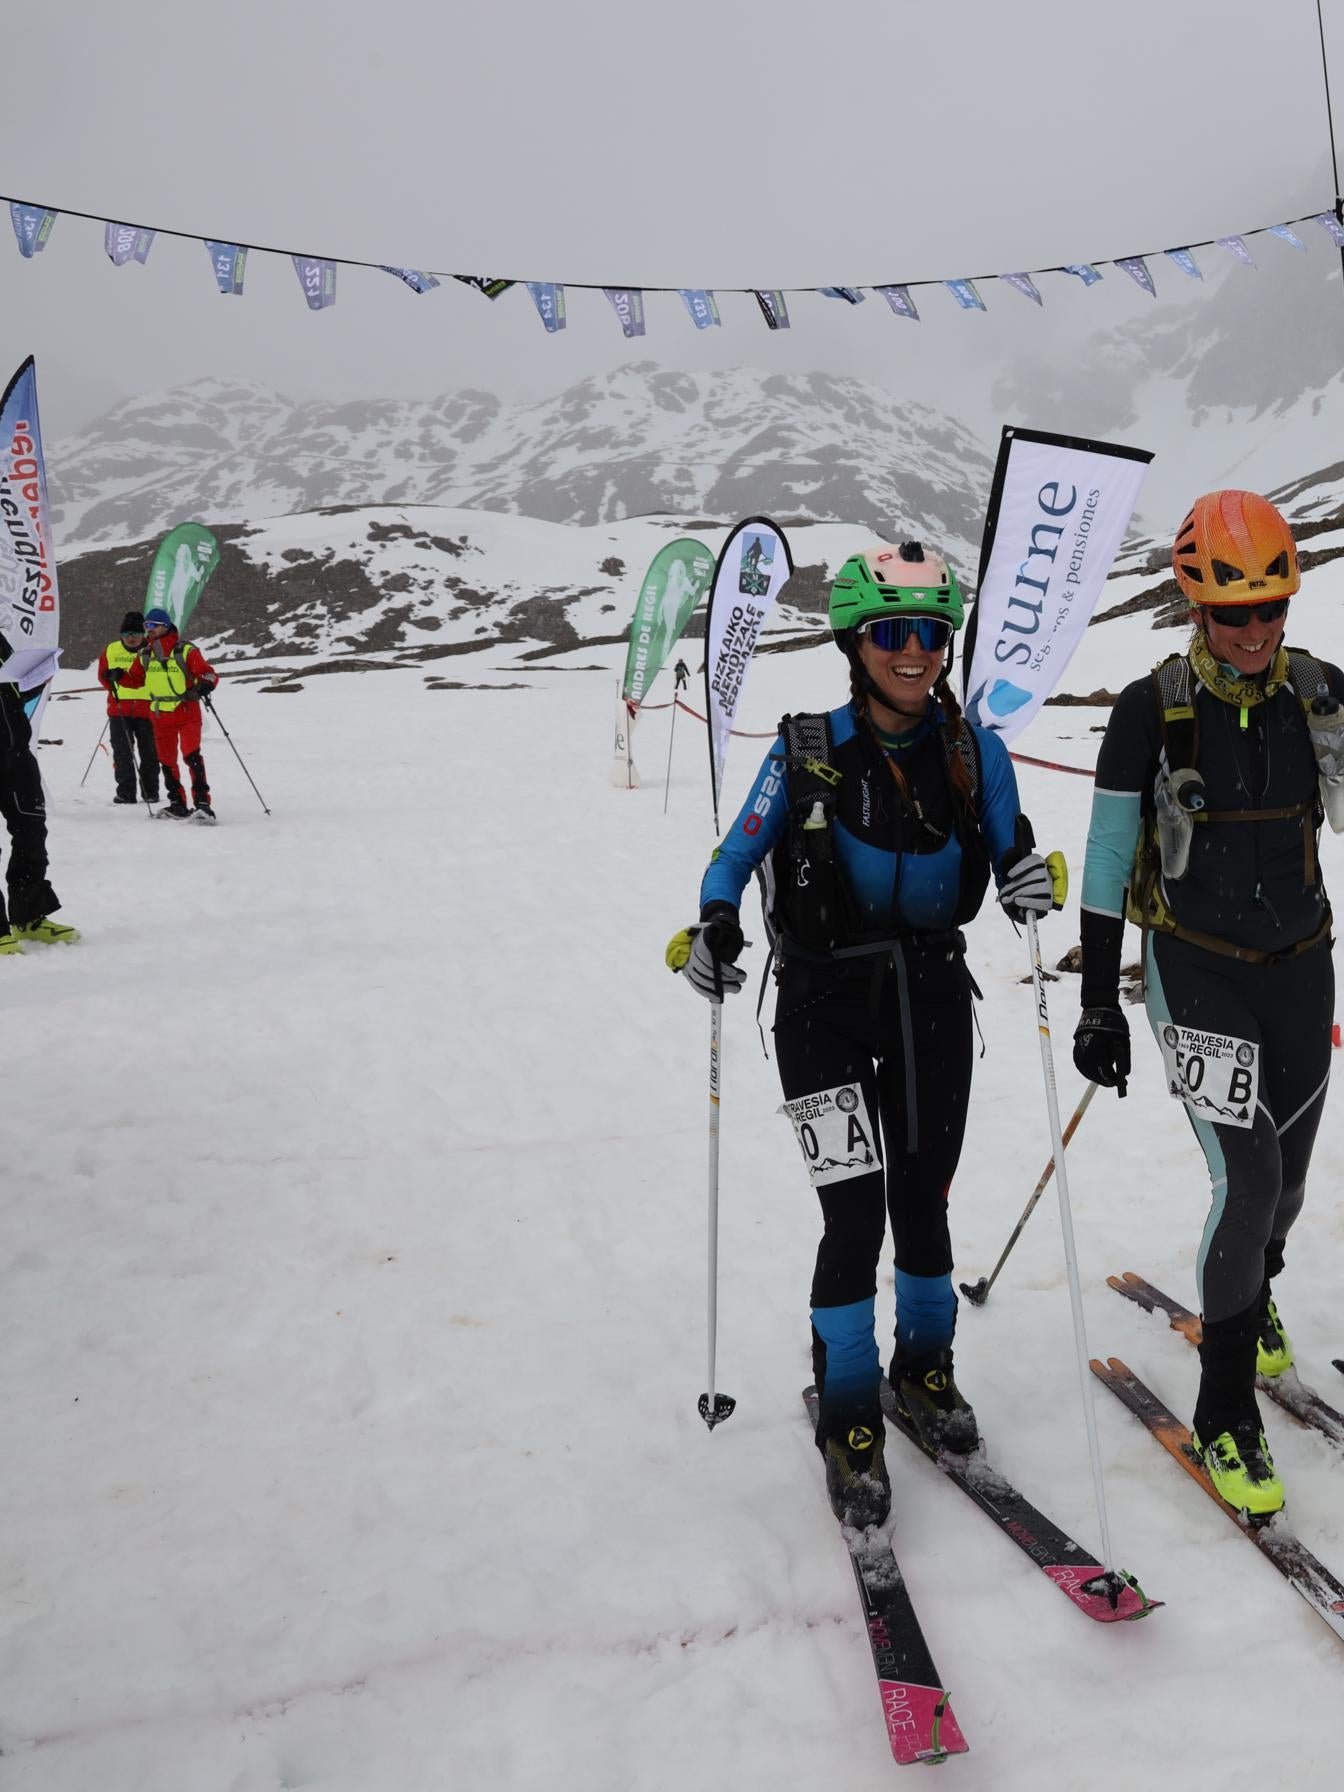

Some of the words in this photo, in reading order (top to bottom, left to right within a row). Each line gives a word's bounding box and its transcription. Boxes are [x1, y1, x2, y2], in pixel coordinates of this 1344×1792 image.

[1065, 488, 1101, 586] pensiones
[994, 481, 1077, 665] surne
[711, 606, 745, 692] BIZKAIKO
[718, 603, 757, 709] MENDIZALE
[1176, 1049, 1205, 1093] 50
[1227, 1066, 1253, 1105] B
[1189, 1042, 1222, 1059] REGIL
[795, 1107, 825, 1122] REGIL
[847, 1113, 871, 1153] A
[884, 1686, 916, 1733] RACE
